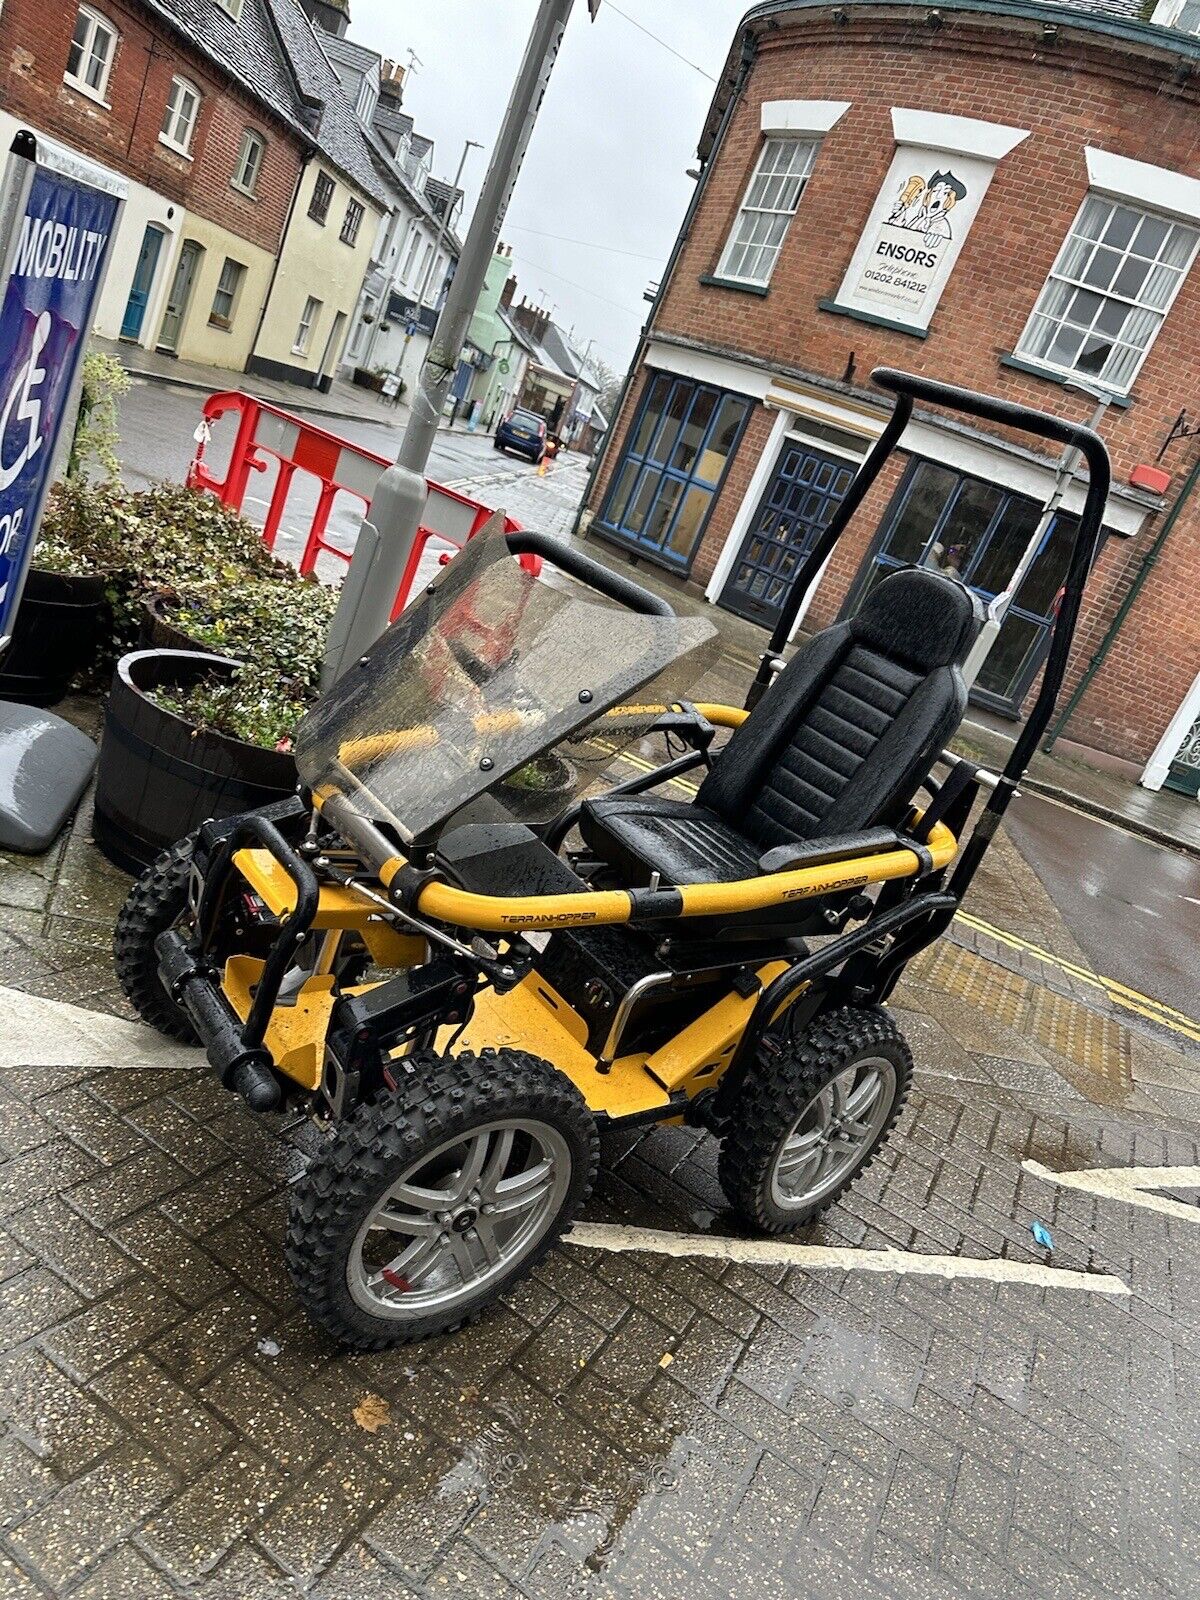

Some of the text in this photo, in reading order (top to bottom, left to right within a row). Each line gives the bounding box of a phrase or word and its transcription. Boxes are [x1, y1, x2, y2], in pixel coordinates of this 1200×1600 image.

[10, 216, 107, 281] MOBILITY
[876, 241, 937, 268] ENSORS
[864, 270, 927, 293] 01202 841212
[501, 912, 597, 923] TERRAINHOPPER
